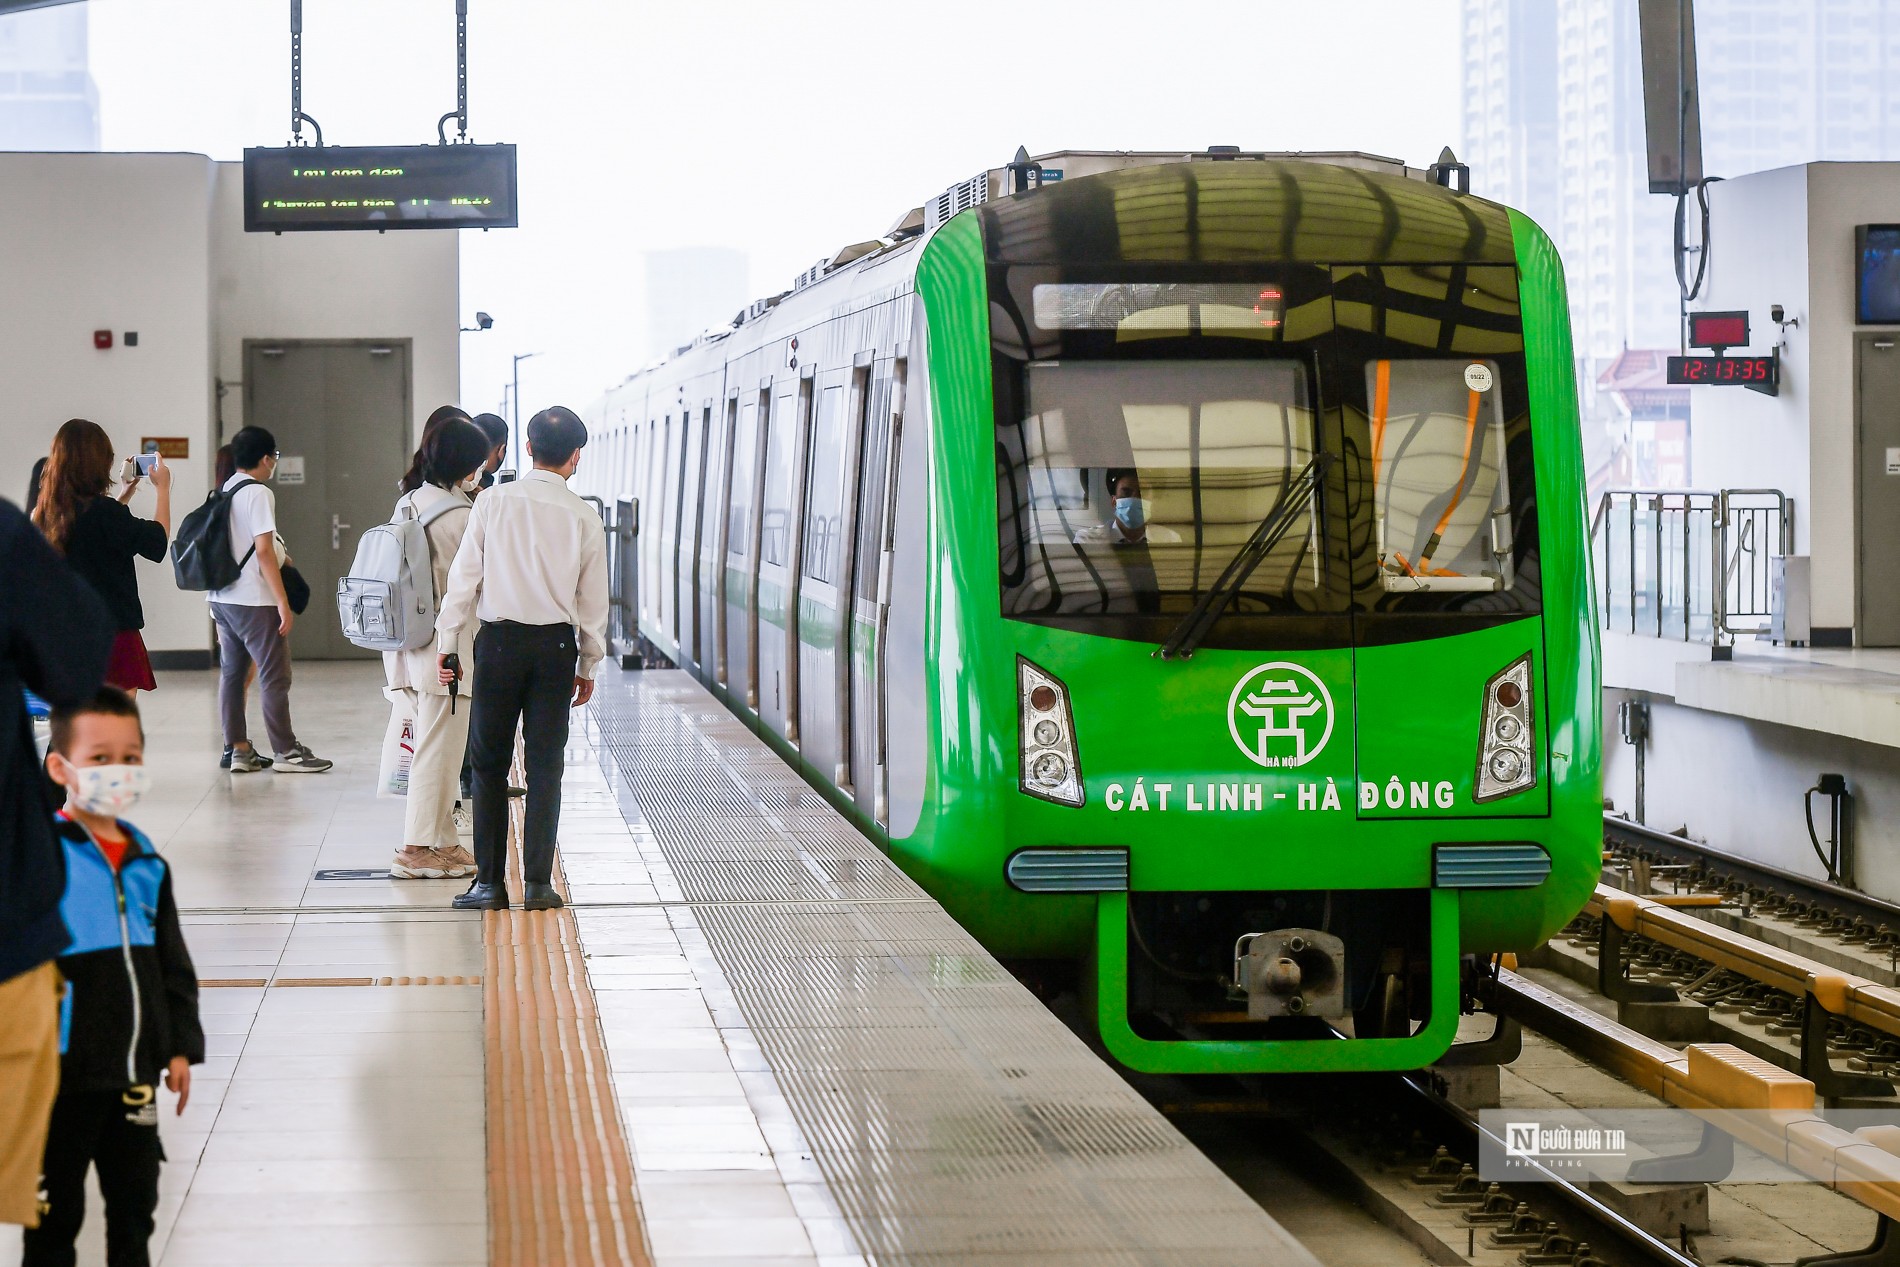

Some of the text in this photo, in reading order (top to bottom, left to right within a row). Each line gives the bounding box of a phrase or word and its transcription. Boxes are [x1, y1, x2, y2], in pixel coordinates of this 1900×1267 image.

[1683, 361, 1767, 379] 12:13:35
[1266, 755, 1297, 769] HÀ NỘI
[1105, 777, 1172, 811] CÁT
[1186, 783, 1263, 811] LINH
[1297, 777, 1342, 811] HÀ
[1360, 775, 1454, 810] ĐÔNG
